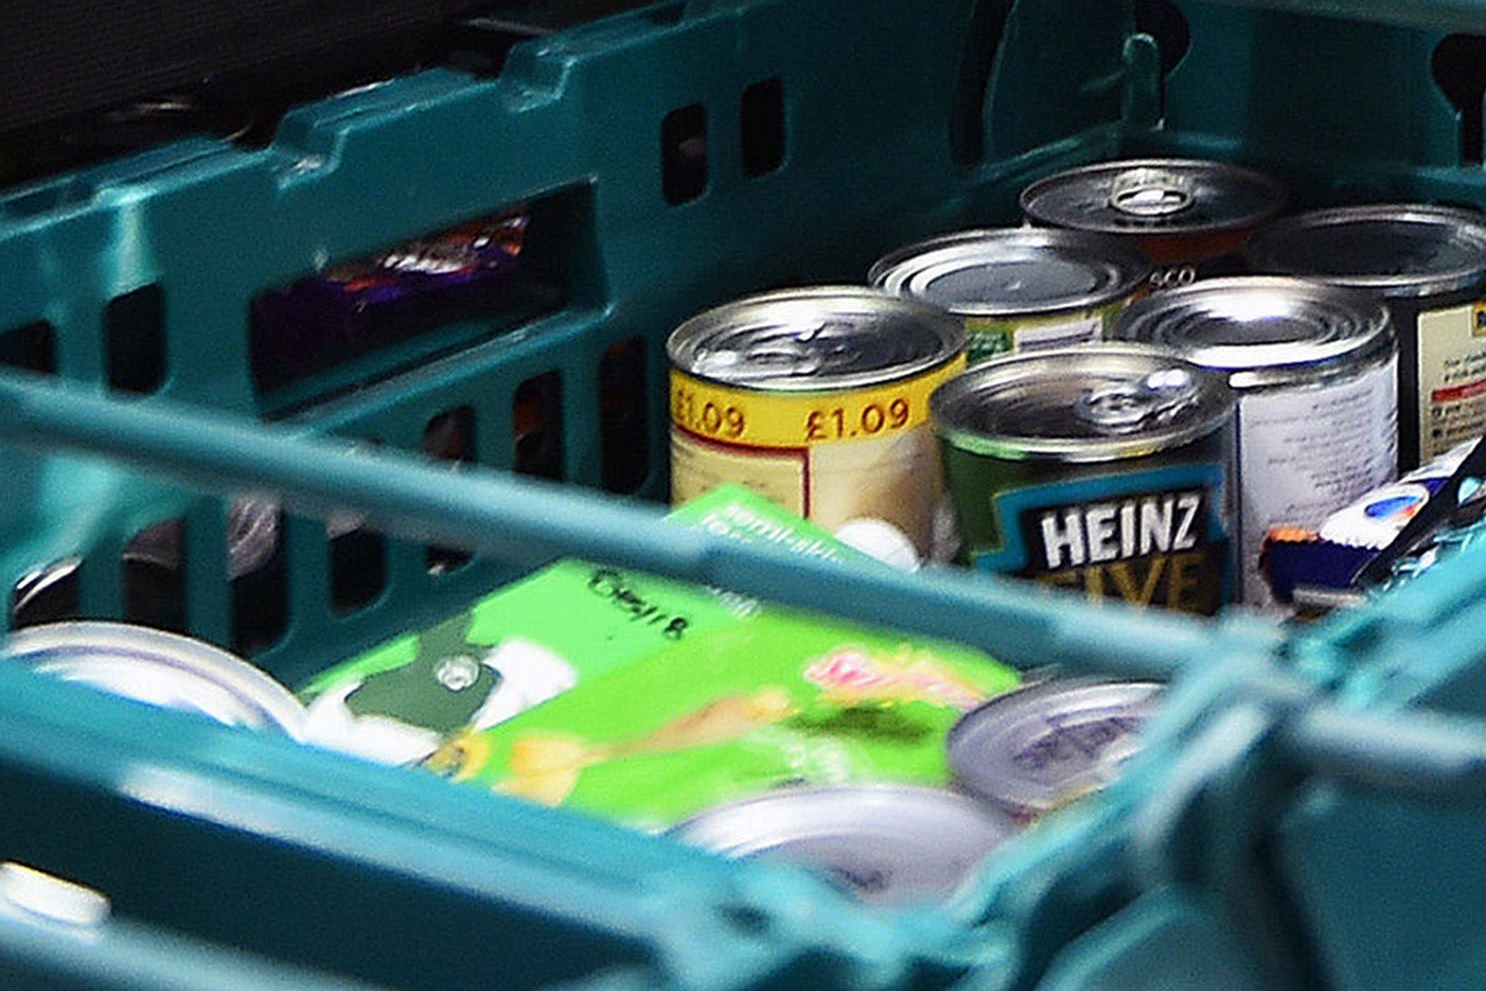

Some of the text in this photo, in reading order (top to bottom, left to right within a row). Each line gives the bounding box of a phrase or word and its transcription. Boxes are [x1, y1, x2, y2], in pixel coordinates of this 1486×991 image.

[805, 398, 910, 442] £1.09
[1041, 494, 1200, 570] HEINZ
[1034, 553, 1204, 612] IVE
